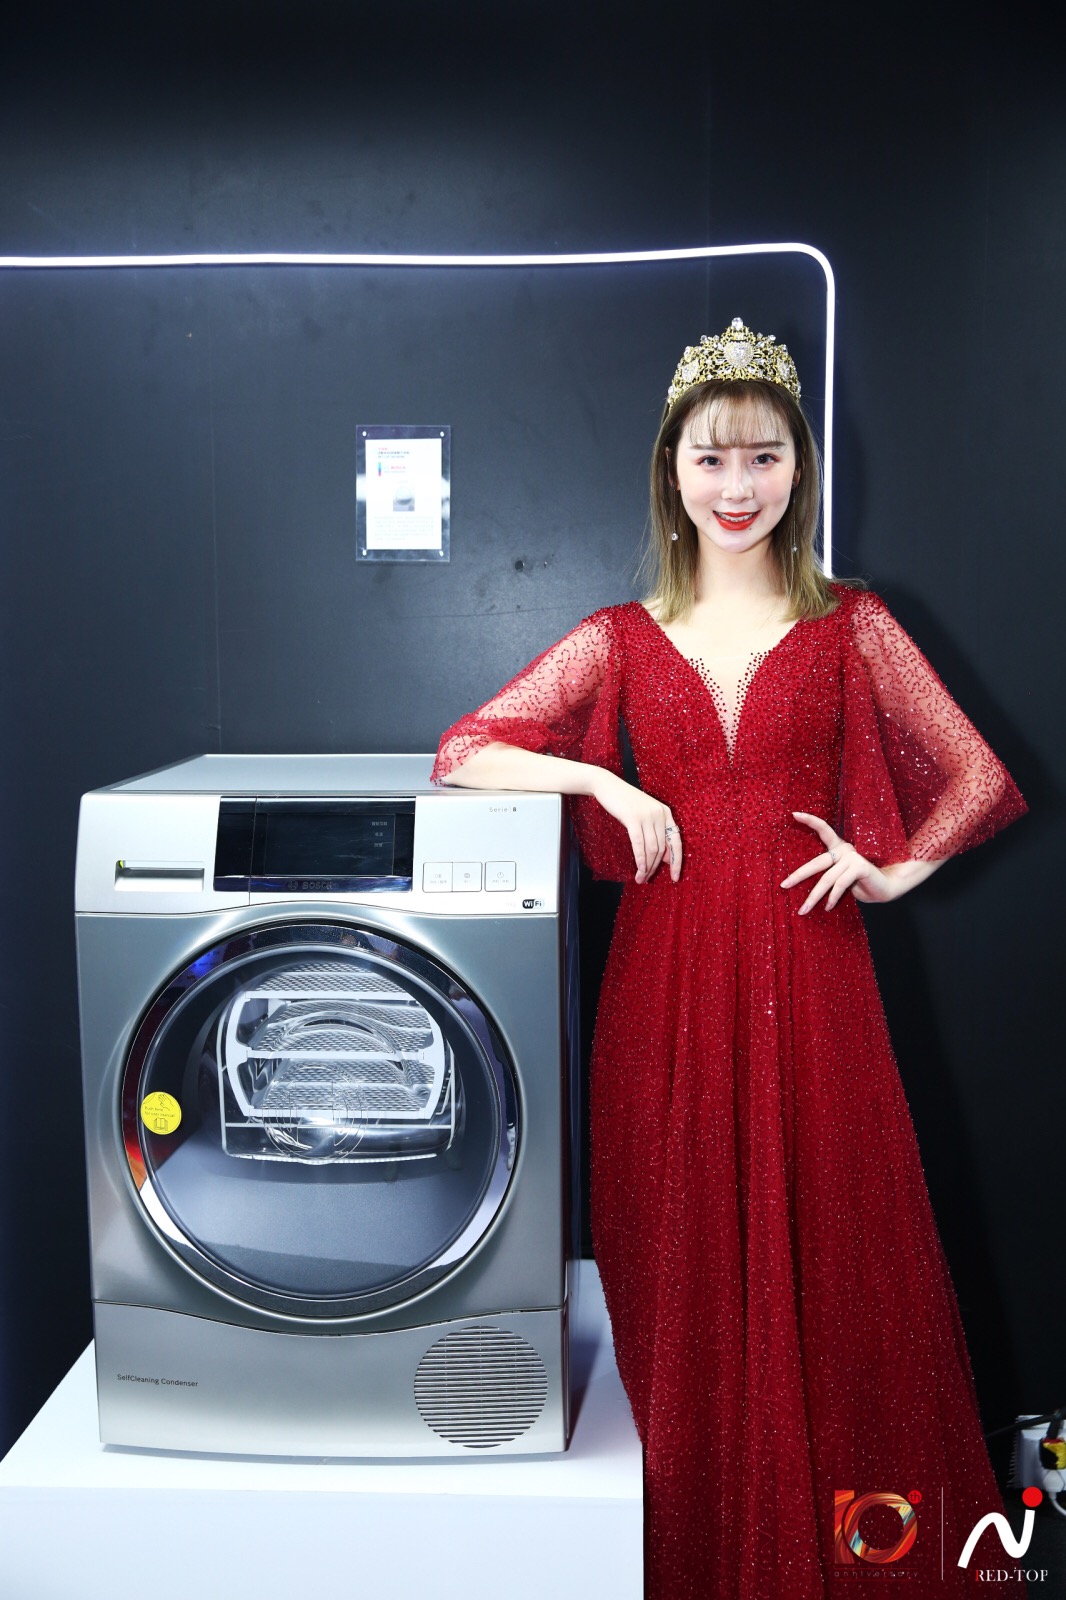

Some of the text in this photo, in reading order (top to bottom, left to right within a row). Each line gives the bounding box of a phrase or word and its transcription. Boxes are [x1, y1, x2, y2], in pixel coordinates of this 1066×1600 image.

[302, 881, 332, 890] BOSCH
[117, 1373, 199, 1387] SelfCleaning Condenser
